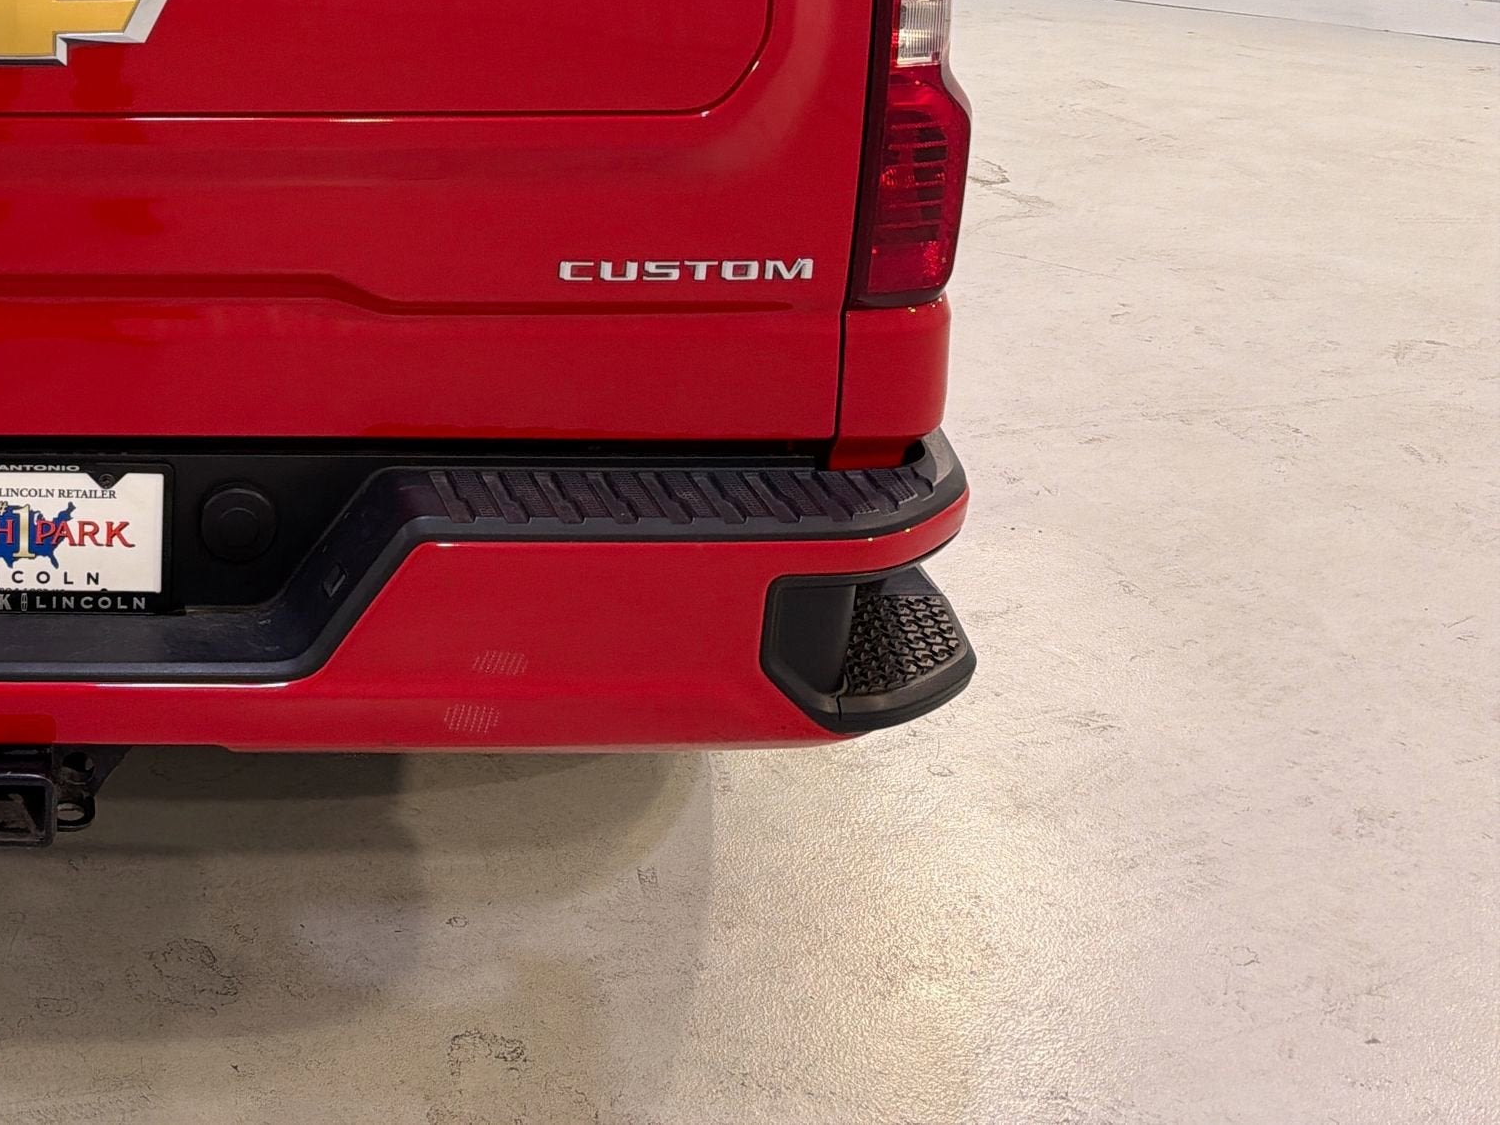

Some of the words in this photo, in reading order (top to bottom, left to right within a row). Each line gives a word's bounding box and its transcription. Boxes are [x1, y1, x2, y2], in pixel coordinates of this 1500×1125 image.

[558, 257, 814, 281] CUSTOM
[58, 488, 116, 499] RETAILER
[35, 520, 135, 548] PARK
[35, 596, 147, 609] LINCOLN
